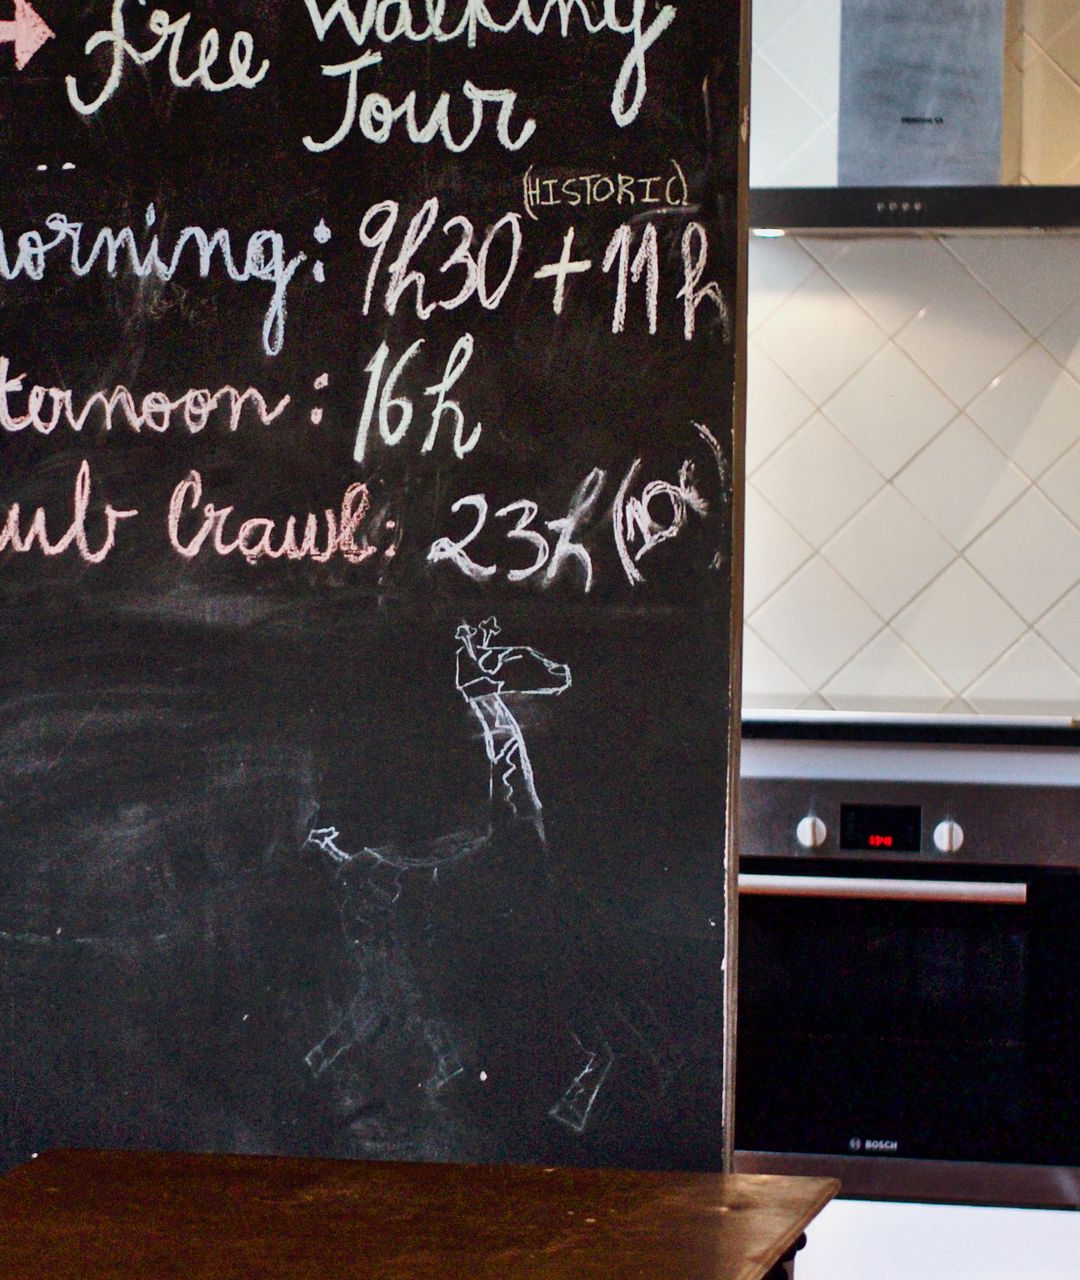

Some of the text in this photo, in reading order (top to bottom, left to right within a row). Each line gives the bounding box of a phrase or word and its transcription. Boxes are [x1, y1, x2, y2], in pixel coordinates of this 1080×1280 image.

[302, 50, 536, 152] Tour
[523, 159, 688, 220] (HISTORIC)
[359, 196, 522, 320] 9h30
[533, 226, 592, 315] +
[354, 332, 483, 463] 16h
[167, 469, 397, 565] Crawl:
[426, 466, 606, 593] 23h
[864, 1139, 898, 1150] BOSCH
